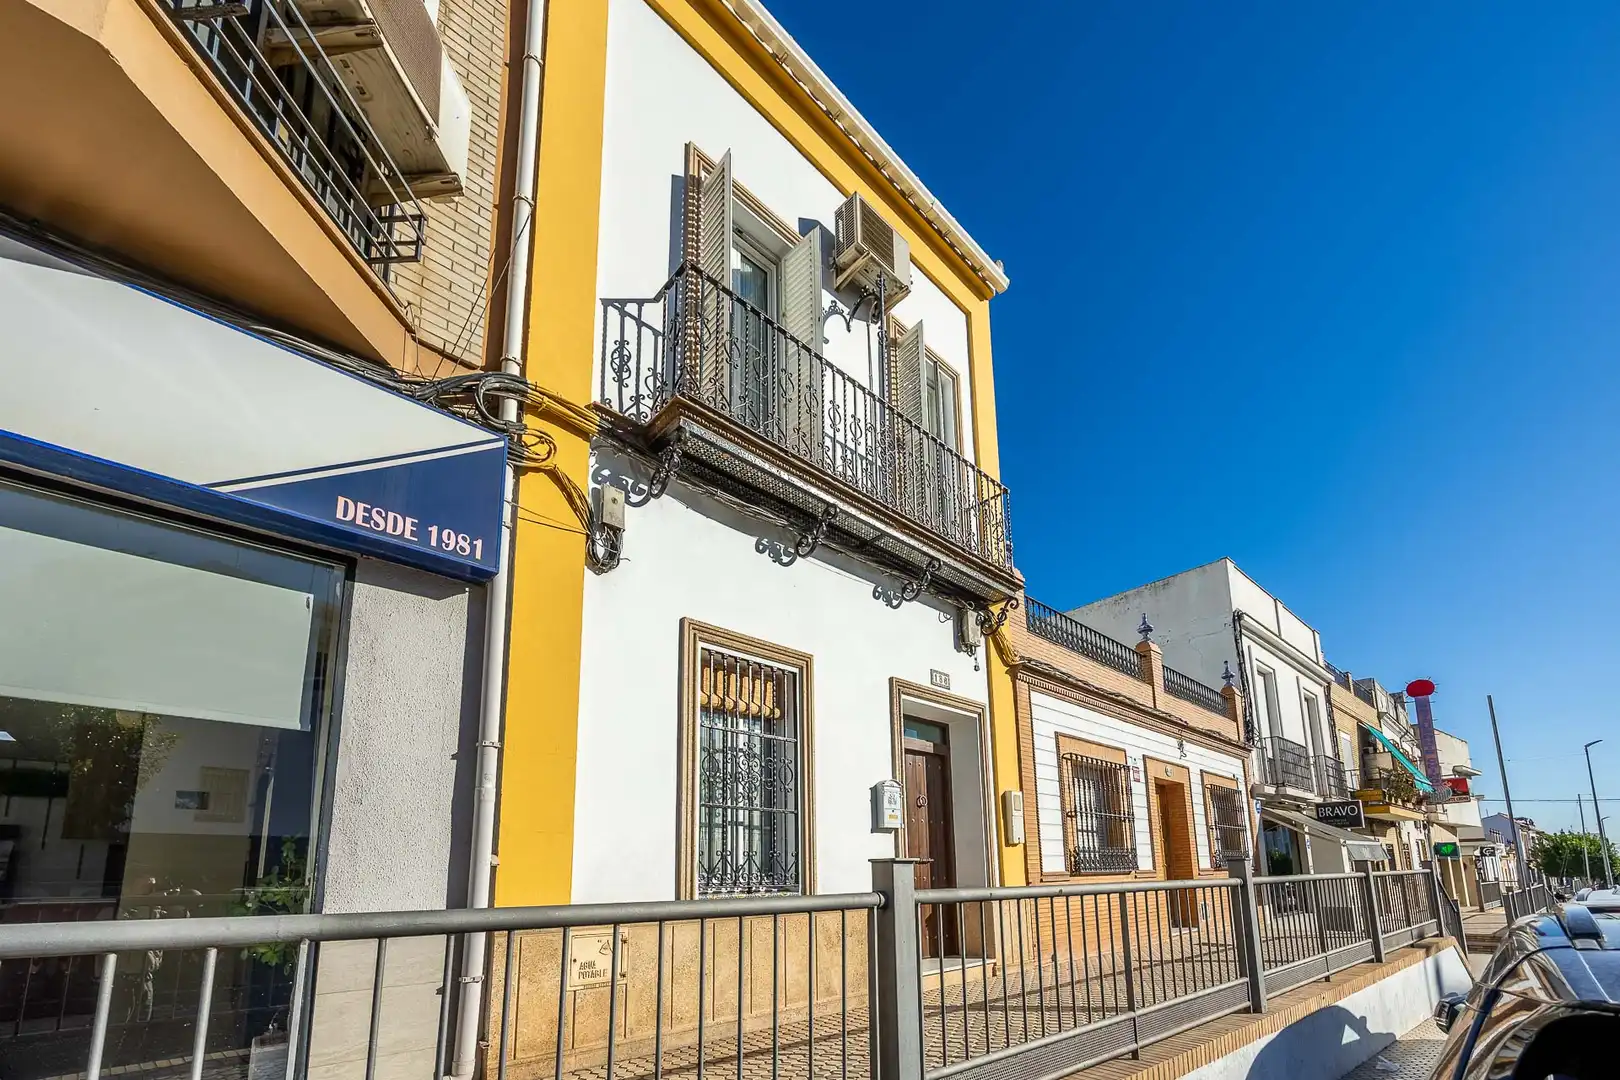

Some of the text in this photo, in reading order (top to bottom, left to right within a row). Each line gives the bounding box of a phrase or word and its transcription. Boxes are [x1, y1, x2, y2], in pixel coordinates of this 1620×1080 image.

[336, 496, 483, 560] DESDE 1981
[1318, 805, 1358, 818] BRAVO
[579, 960, 597, 971] AGUA
